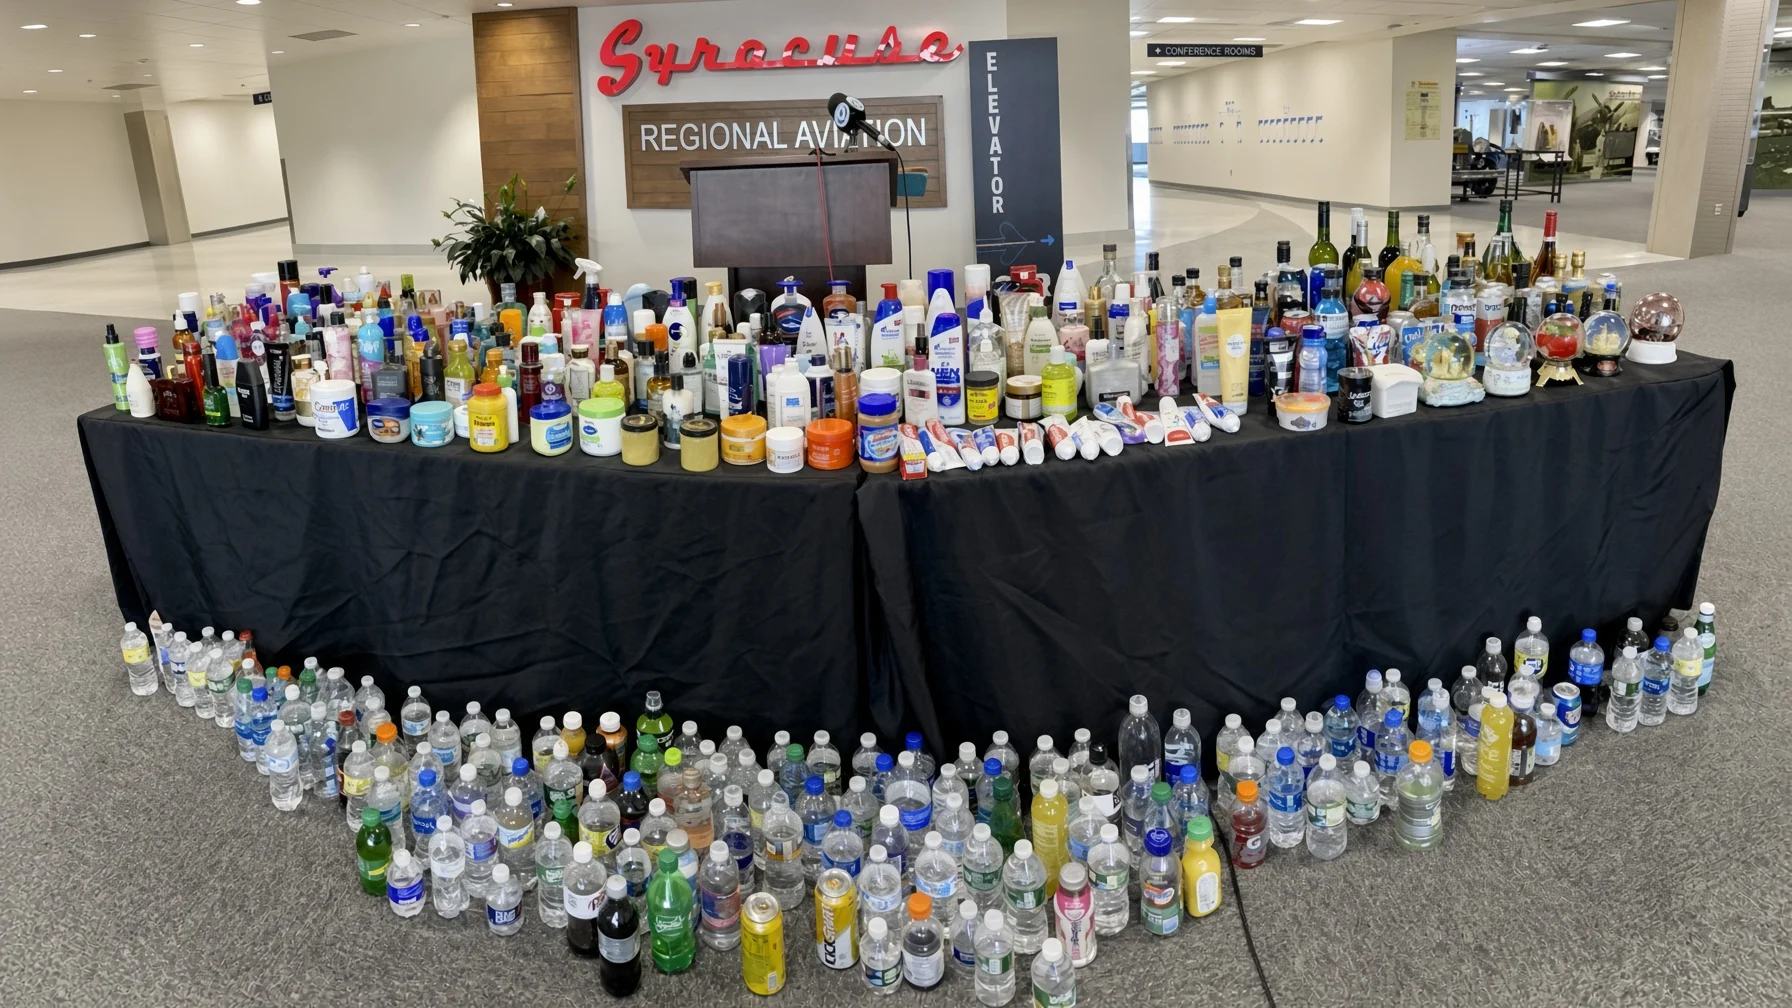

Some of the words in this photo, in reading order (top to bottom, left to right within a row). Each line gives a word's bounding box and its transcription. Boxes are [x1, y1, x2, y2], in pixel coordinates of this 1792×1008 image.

[597, 18, 964, 96] Syracuse
[1165, 46, 1222, 56] CONFERENCE
[1224, 47, 1256, 56] ROOMS
[640, 121, 788, 151] REGIONAL
[986, 52, 1004, 213] ELEVATOR
